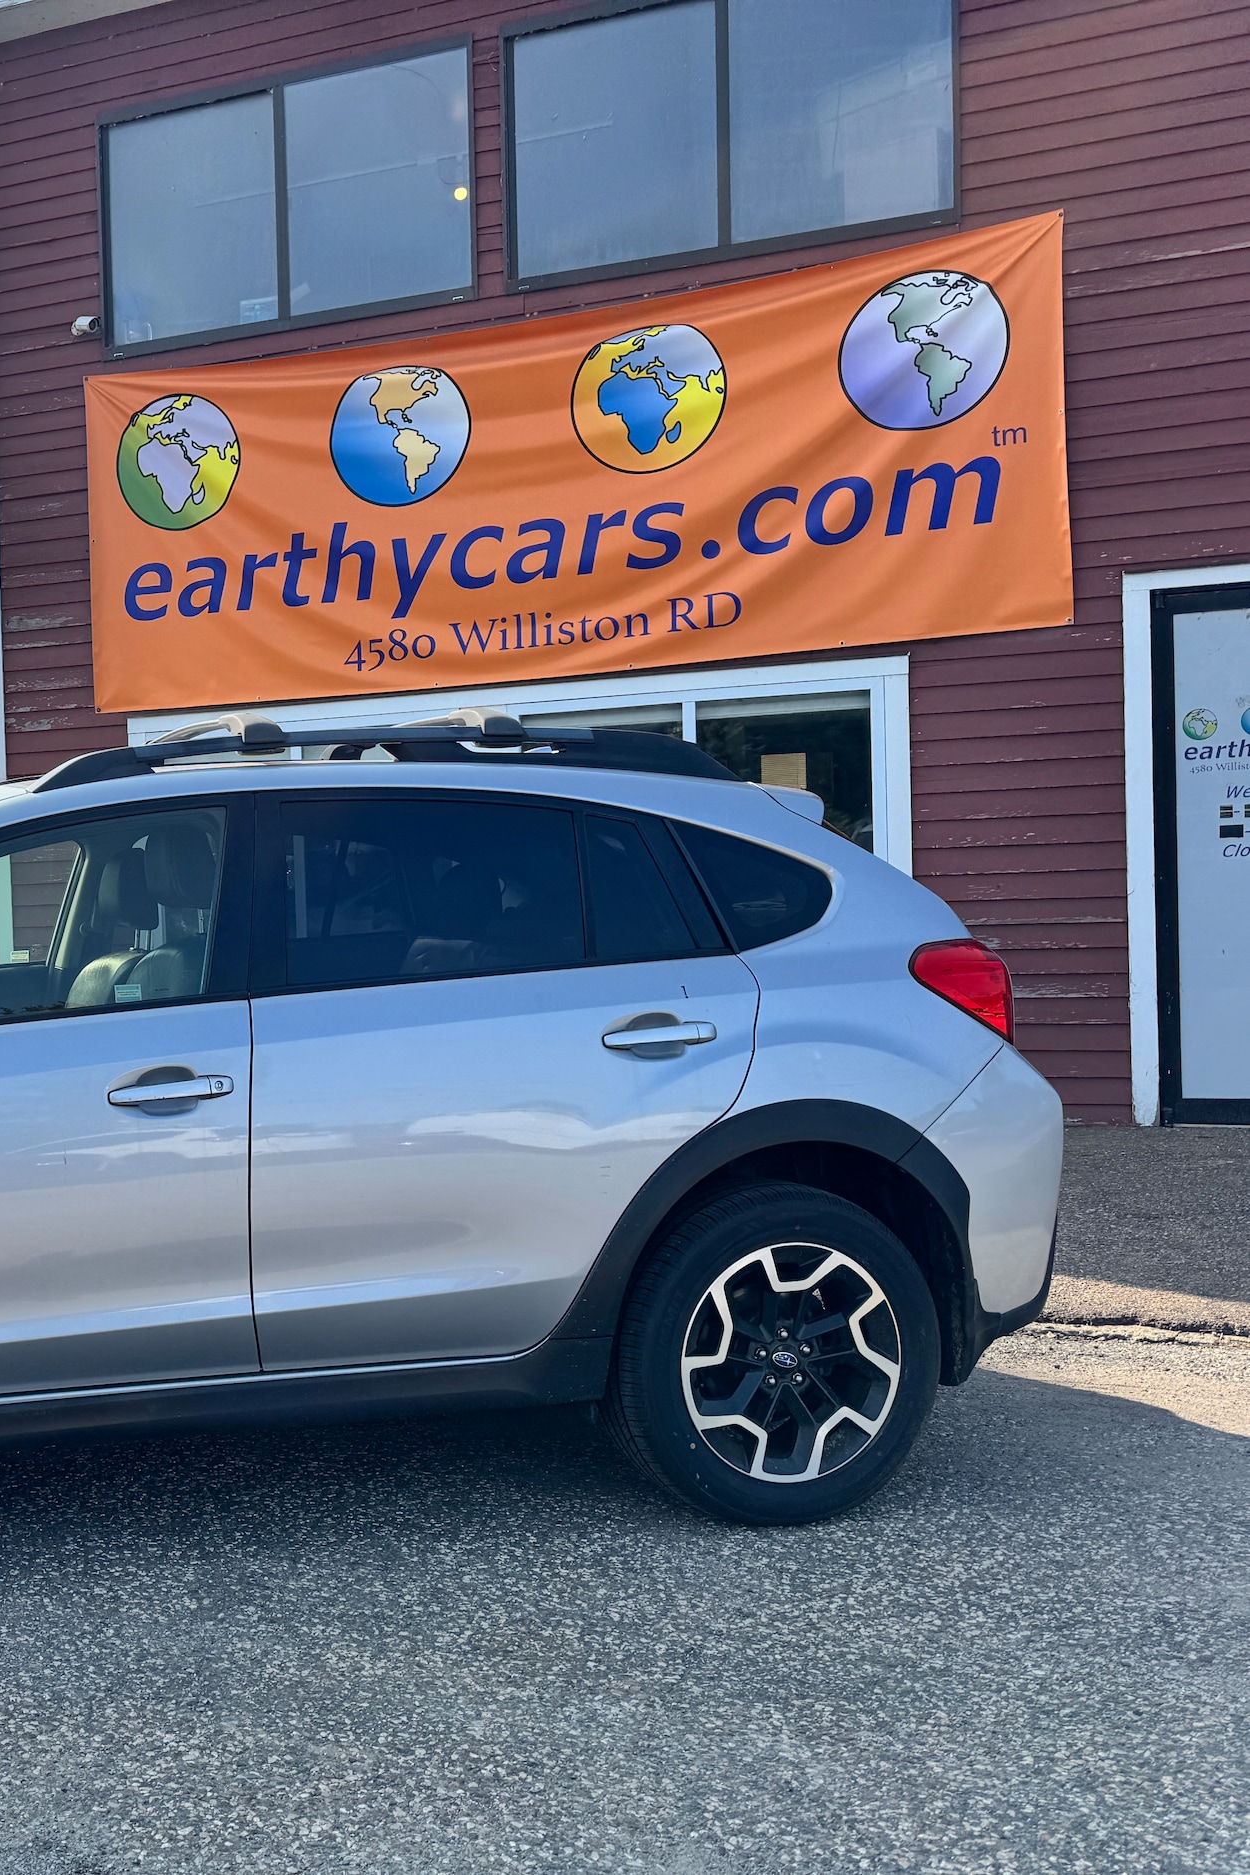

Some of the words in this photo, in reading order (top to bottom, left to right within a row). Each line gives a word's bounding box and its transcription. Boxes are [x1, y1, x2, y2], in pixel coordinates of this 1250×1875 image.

[123, 455, 1002, 622] earthycars.com
[991, 425, 1028, 447] tm
[343, 628, 437, 672] 4580
[449, 609, 650, 656] Williston
[666, 591, 742, 633] RD
[1189, 764, 1213, 774] 4580
[1215, 761, 1250, 771] Willist
